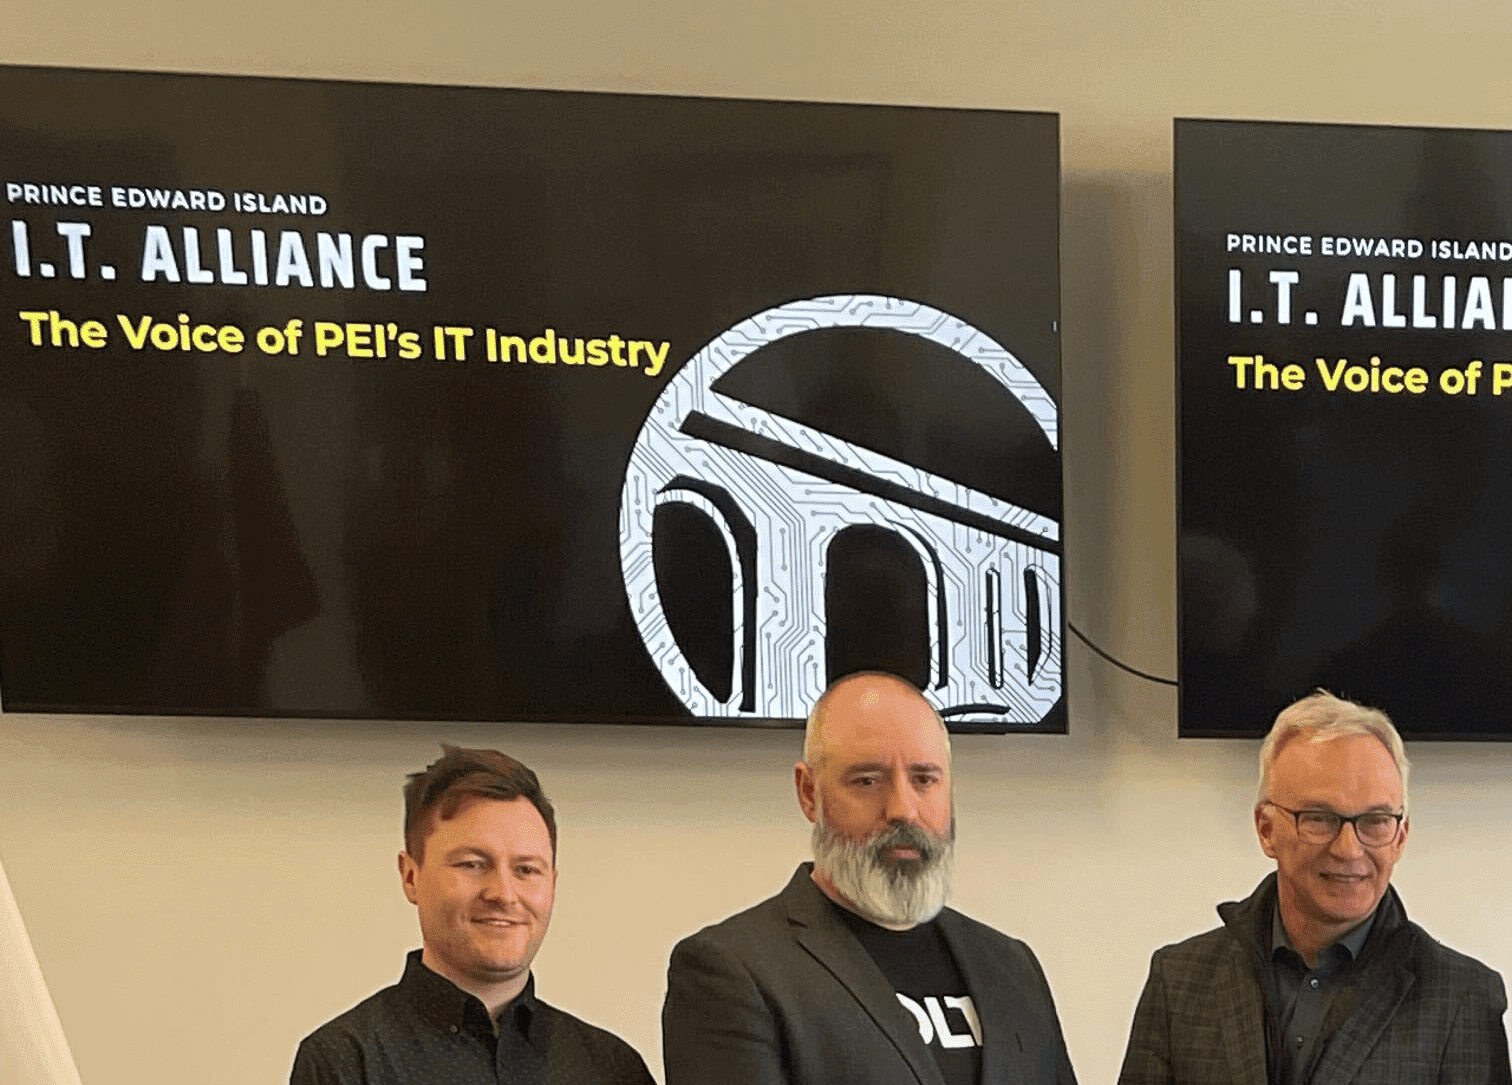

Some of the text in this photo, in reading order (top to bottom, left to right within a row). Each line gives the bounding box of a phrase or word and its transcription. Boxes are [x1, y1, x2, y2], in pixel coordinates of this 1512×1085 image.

[6, 182, 327, 215] PRINCE EDWARD ISLAND
[12, 220, 427, 292] I.T. ALLIANCE
[1227, 233, 1313, 255] PRINCE
[1321, 236, 1424, 259] EDWARD
[1229, 269, 1319, 325] I.T.
[19, 310, 671, 377] The Voice of PEI’s IT Industry
[1227, 354, 1306, 391] The
[1315, 356, 1429, 394] Voice
[1439, 360, 1483, 395] of
